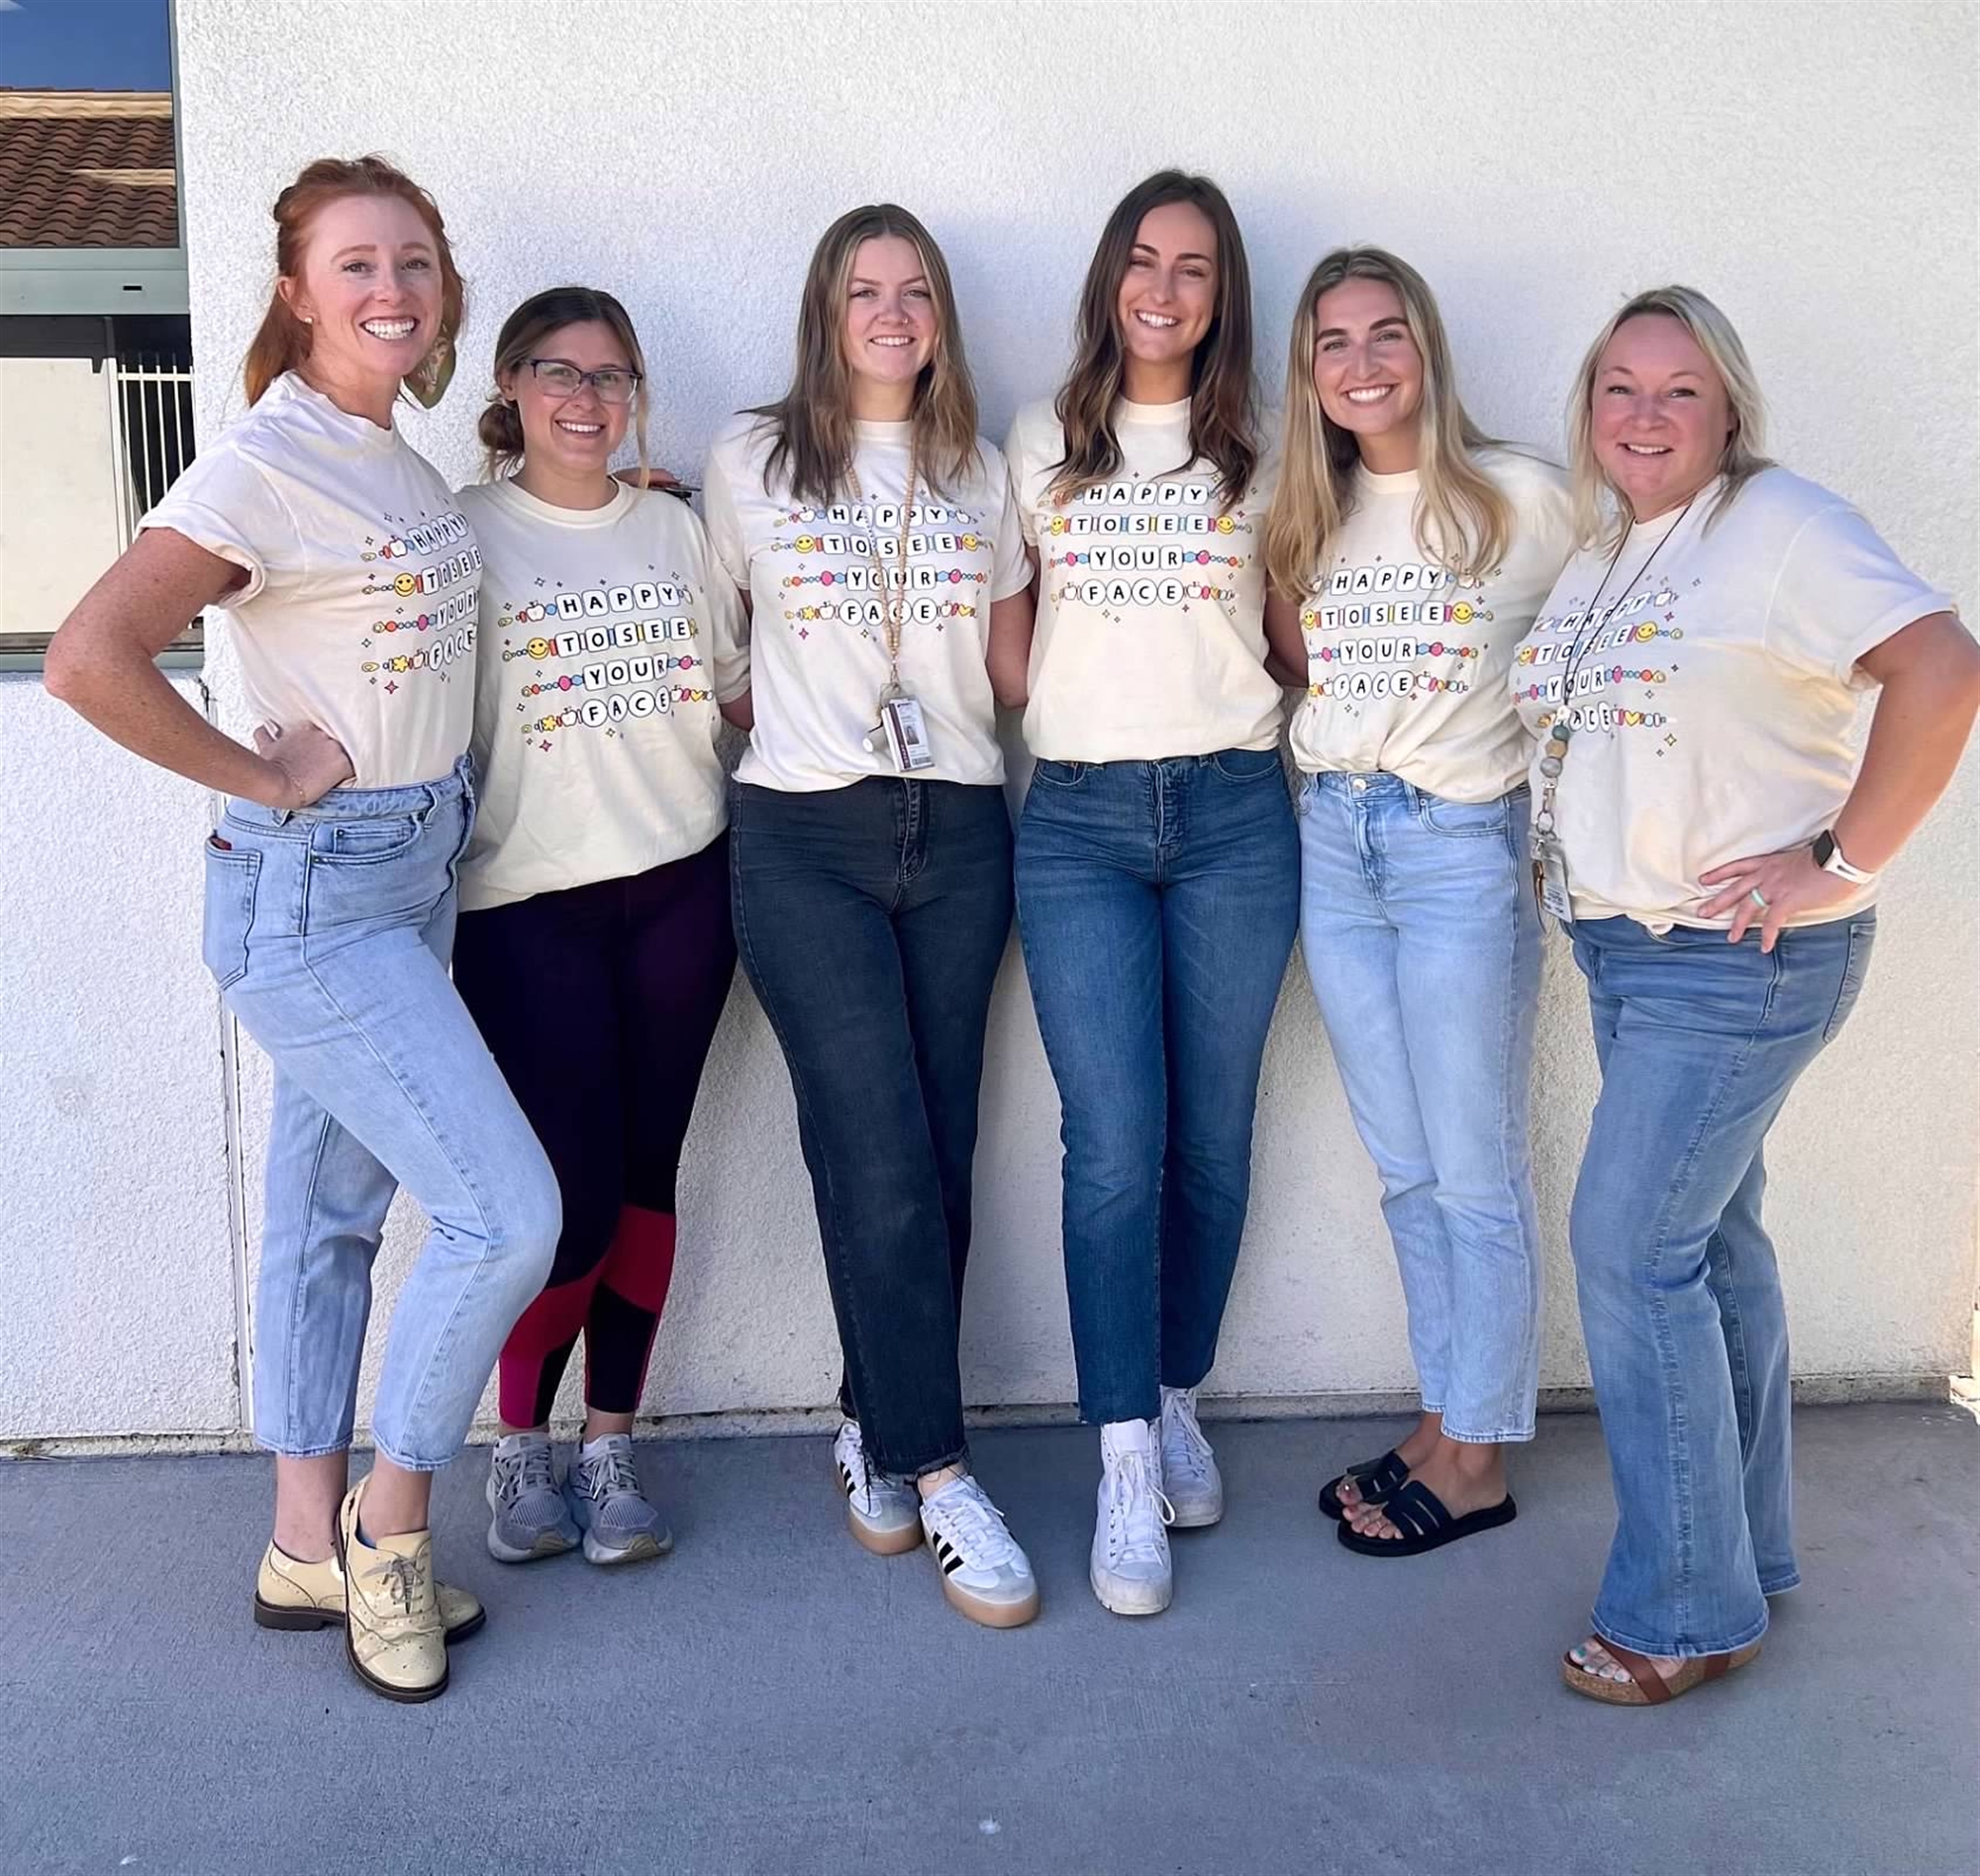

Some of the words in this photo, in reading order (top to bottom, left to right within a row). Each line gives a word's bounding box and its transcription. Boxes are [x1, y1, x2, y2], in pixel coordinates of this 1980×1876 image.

[1089, 488, 1202, 501] HAPPY
[1095, 551, 1178, 565] YOUR
[1336, 571, 1439, 589] HAPPY
[562, 587, 673, 613] HAPPY
[1089, 585, 1175, 600] FACE
[1345, 643, 1411, 660] YOUR
[589, 659, 665, 685] YOUR
[1340, 677, 1408, 693] FACE
[589, 693, 667, 721] FACE
